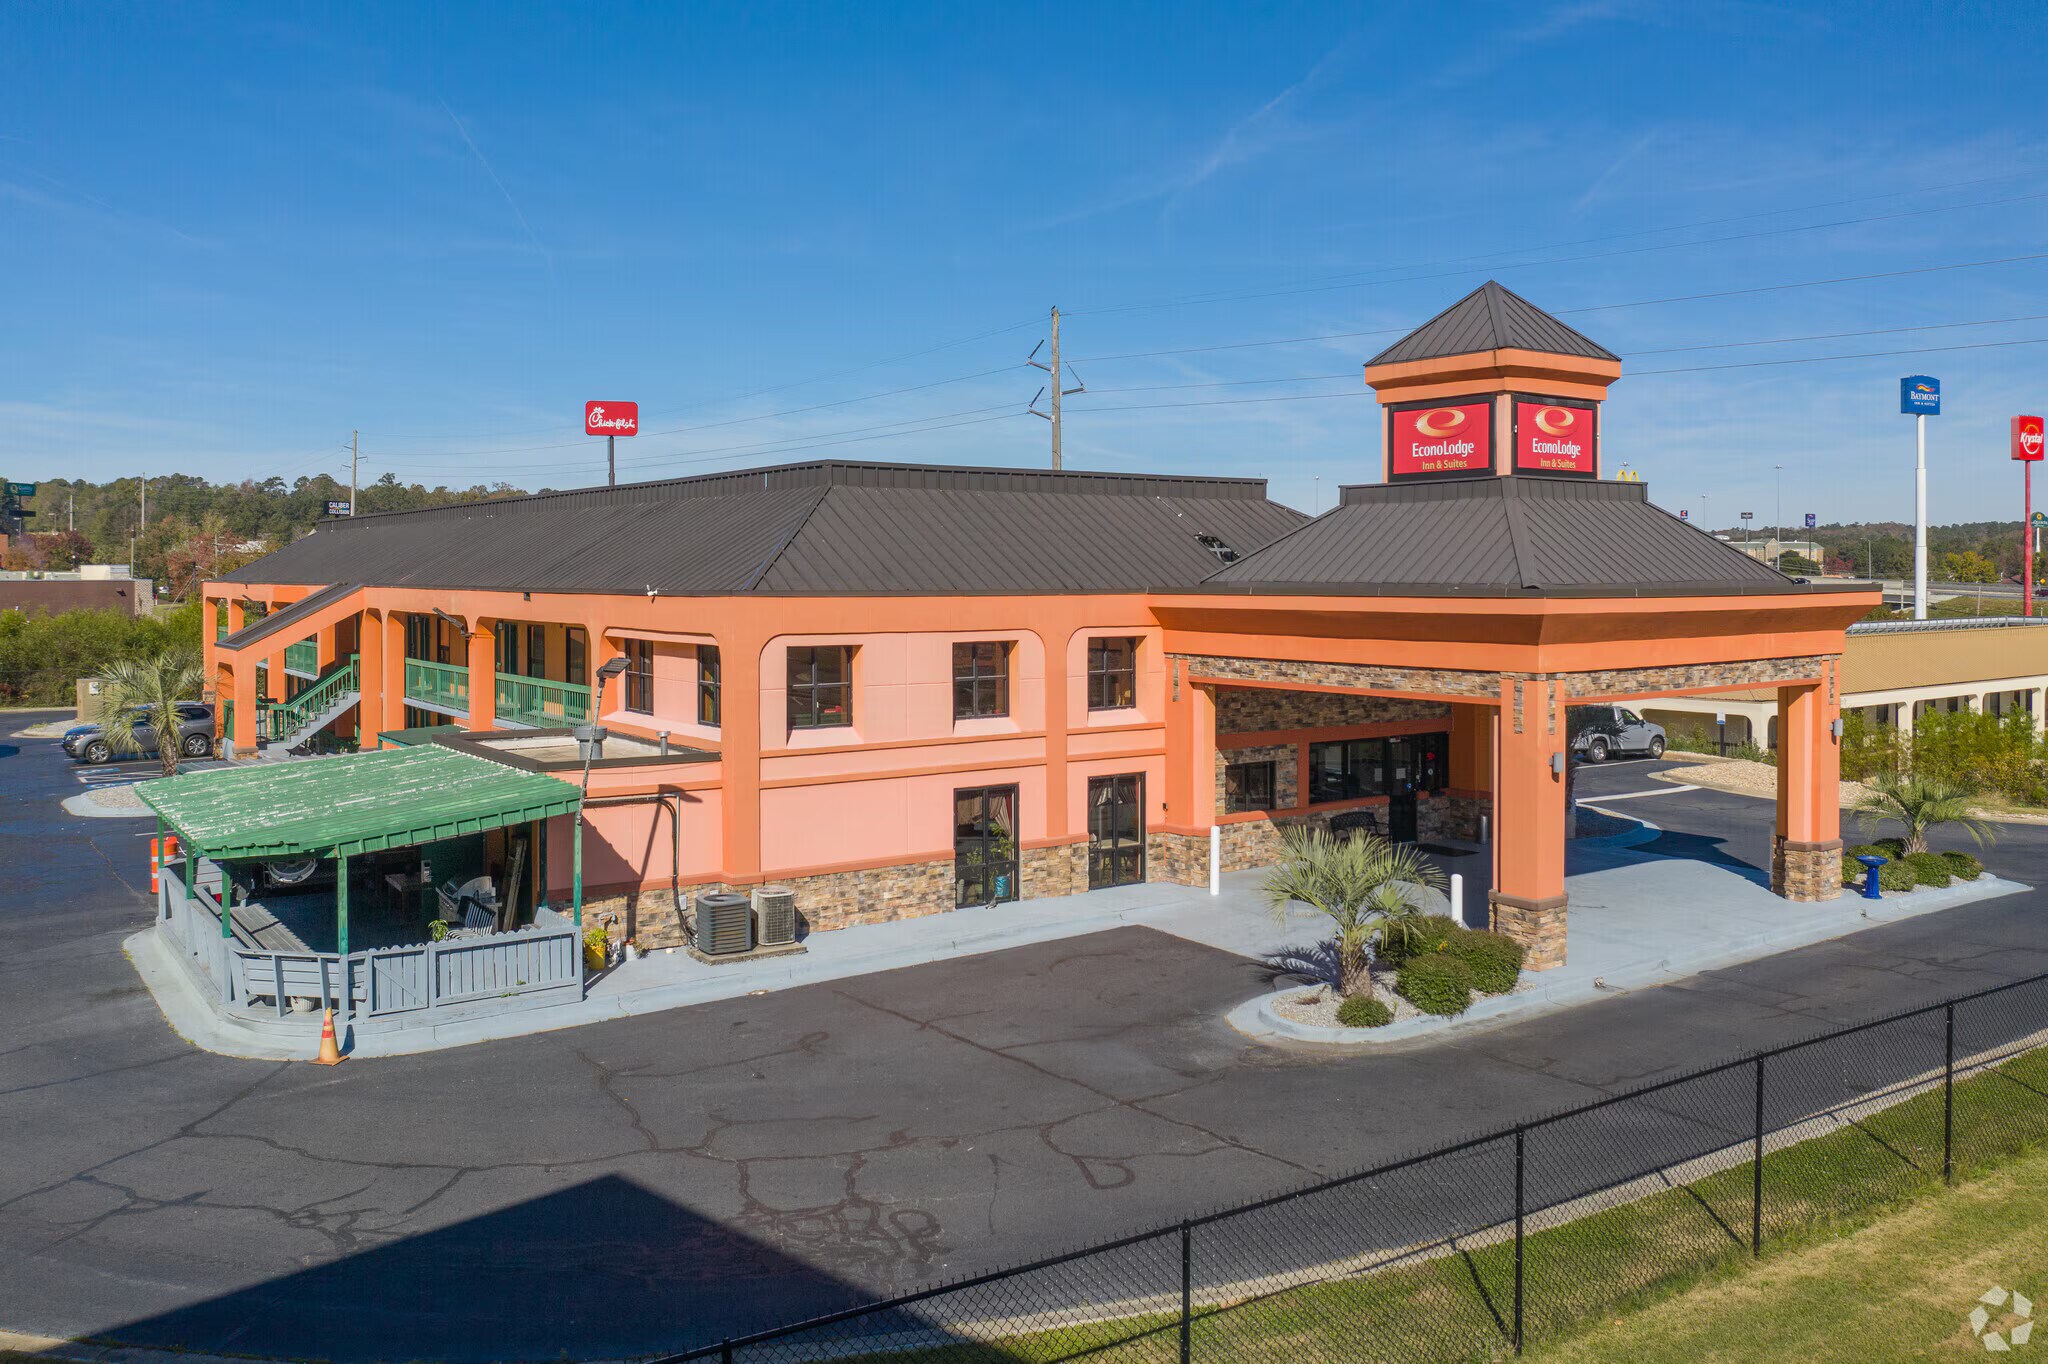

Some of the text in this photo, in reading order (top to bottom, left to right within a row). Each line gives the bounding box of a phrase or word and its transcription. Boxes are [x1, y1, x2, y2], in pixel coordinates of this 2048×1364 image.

[2020, 431, 2044, 447] Krystal
[1412, 440, 1475, 458] EconoLodge
[1532, 437, 1582, 459] EconoLodge
[1422, 459, 1468, 470] Inn & Suites
[1540, 458, 1576, 469] Inn & Suites
[328, 501, 350, 509] CALIBER
